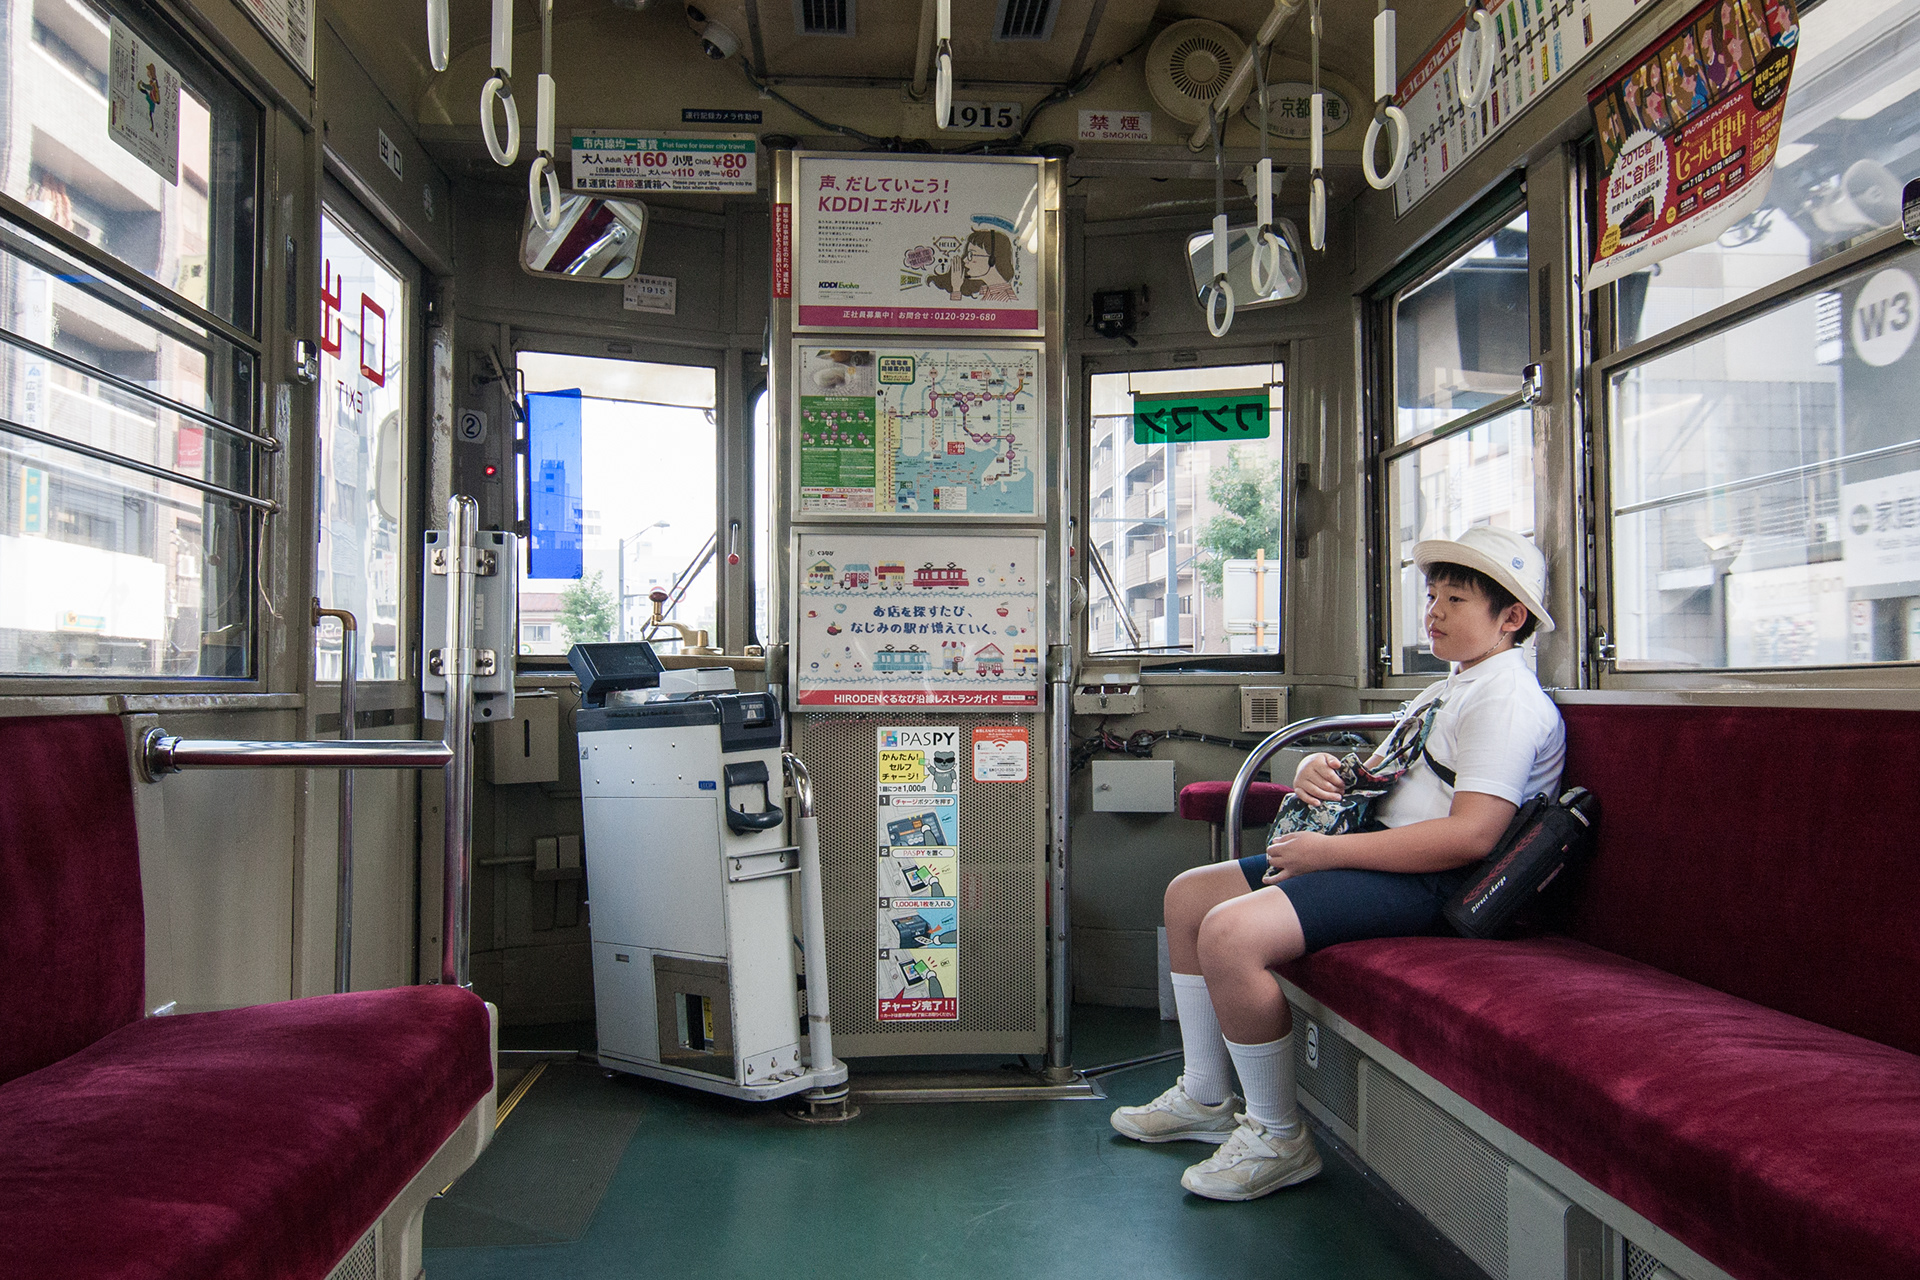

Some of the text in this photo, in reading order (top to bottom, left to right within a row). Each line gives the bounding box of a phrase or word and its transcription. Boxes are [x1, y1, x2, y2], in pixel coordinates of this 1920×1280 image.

[685, 111, 760, 121] 運行記録カメラ作動中
[948, 106, 1014, 129] 1915
[1089, 114, 1140, 131] 禁煙
[1103, 131, 1148, 139] SMOKING
[583, 138, 658, 150] 市内線均一運賃
[1674, 109, 1747, 181] ビール電車
[380, 134, 403, 177] 出口
[582, 153, 603, 165] 大人
[623, 152, 668, 167] ¥160
[672, 155, 693, 167] 小児
[712, 153, 747, 169] ¥80
[671, 168, 695, 177] ¥110
[720, 169, 741, 178] ¥60
[589, 179, 671, 189] 運賃は直接運賃箱へ
[818, 175, 949, 194] 声、だしていこう!
[642, 286, 666, 295] 1915
[818, 281, 860, 289] KDDI Evolva
[842, 310, 894, 320] 正社員募集中!
[1859, 292, 1912, 343] W3
[321, 258, 386, 388] 出口
[873, 605, 974, 619] お店を探すたび、
[850, 622, 997, 636] なじみの駅が増えていく。
[834, 693, 998, 705] HIRODENぐるなび沿線レストランガイド
[901, 732, 955, 746] PASPY
[881, 753, 919, 762] かんたん!
[889, 763, 912, 771] セルフ
[881, 773, 919, 781] チャージ!
[881, 1000, 955, 1011] チャージ完了!!
